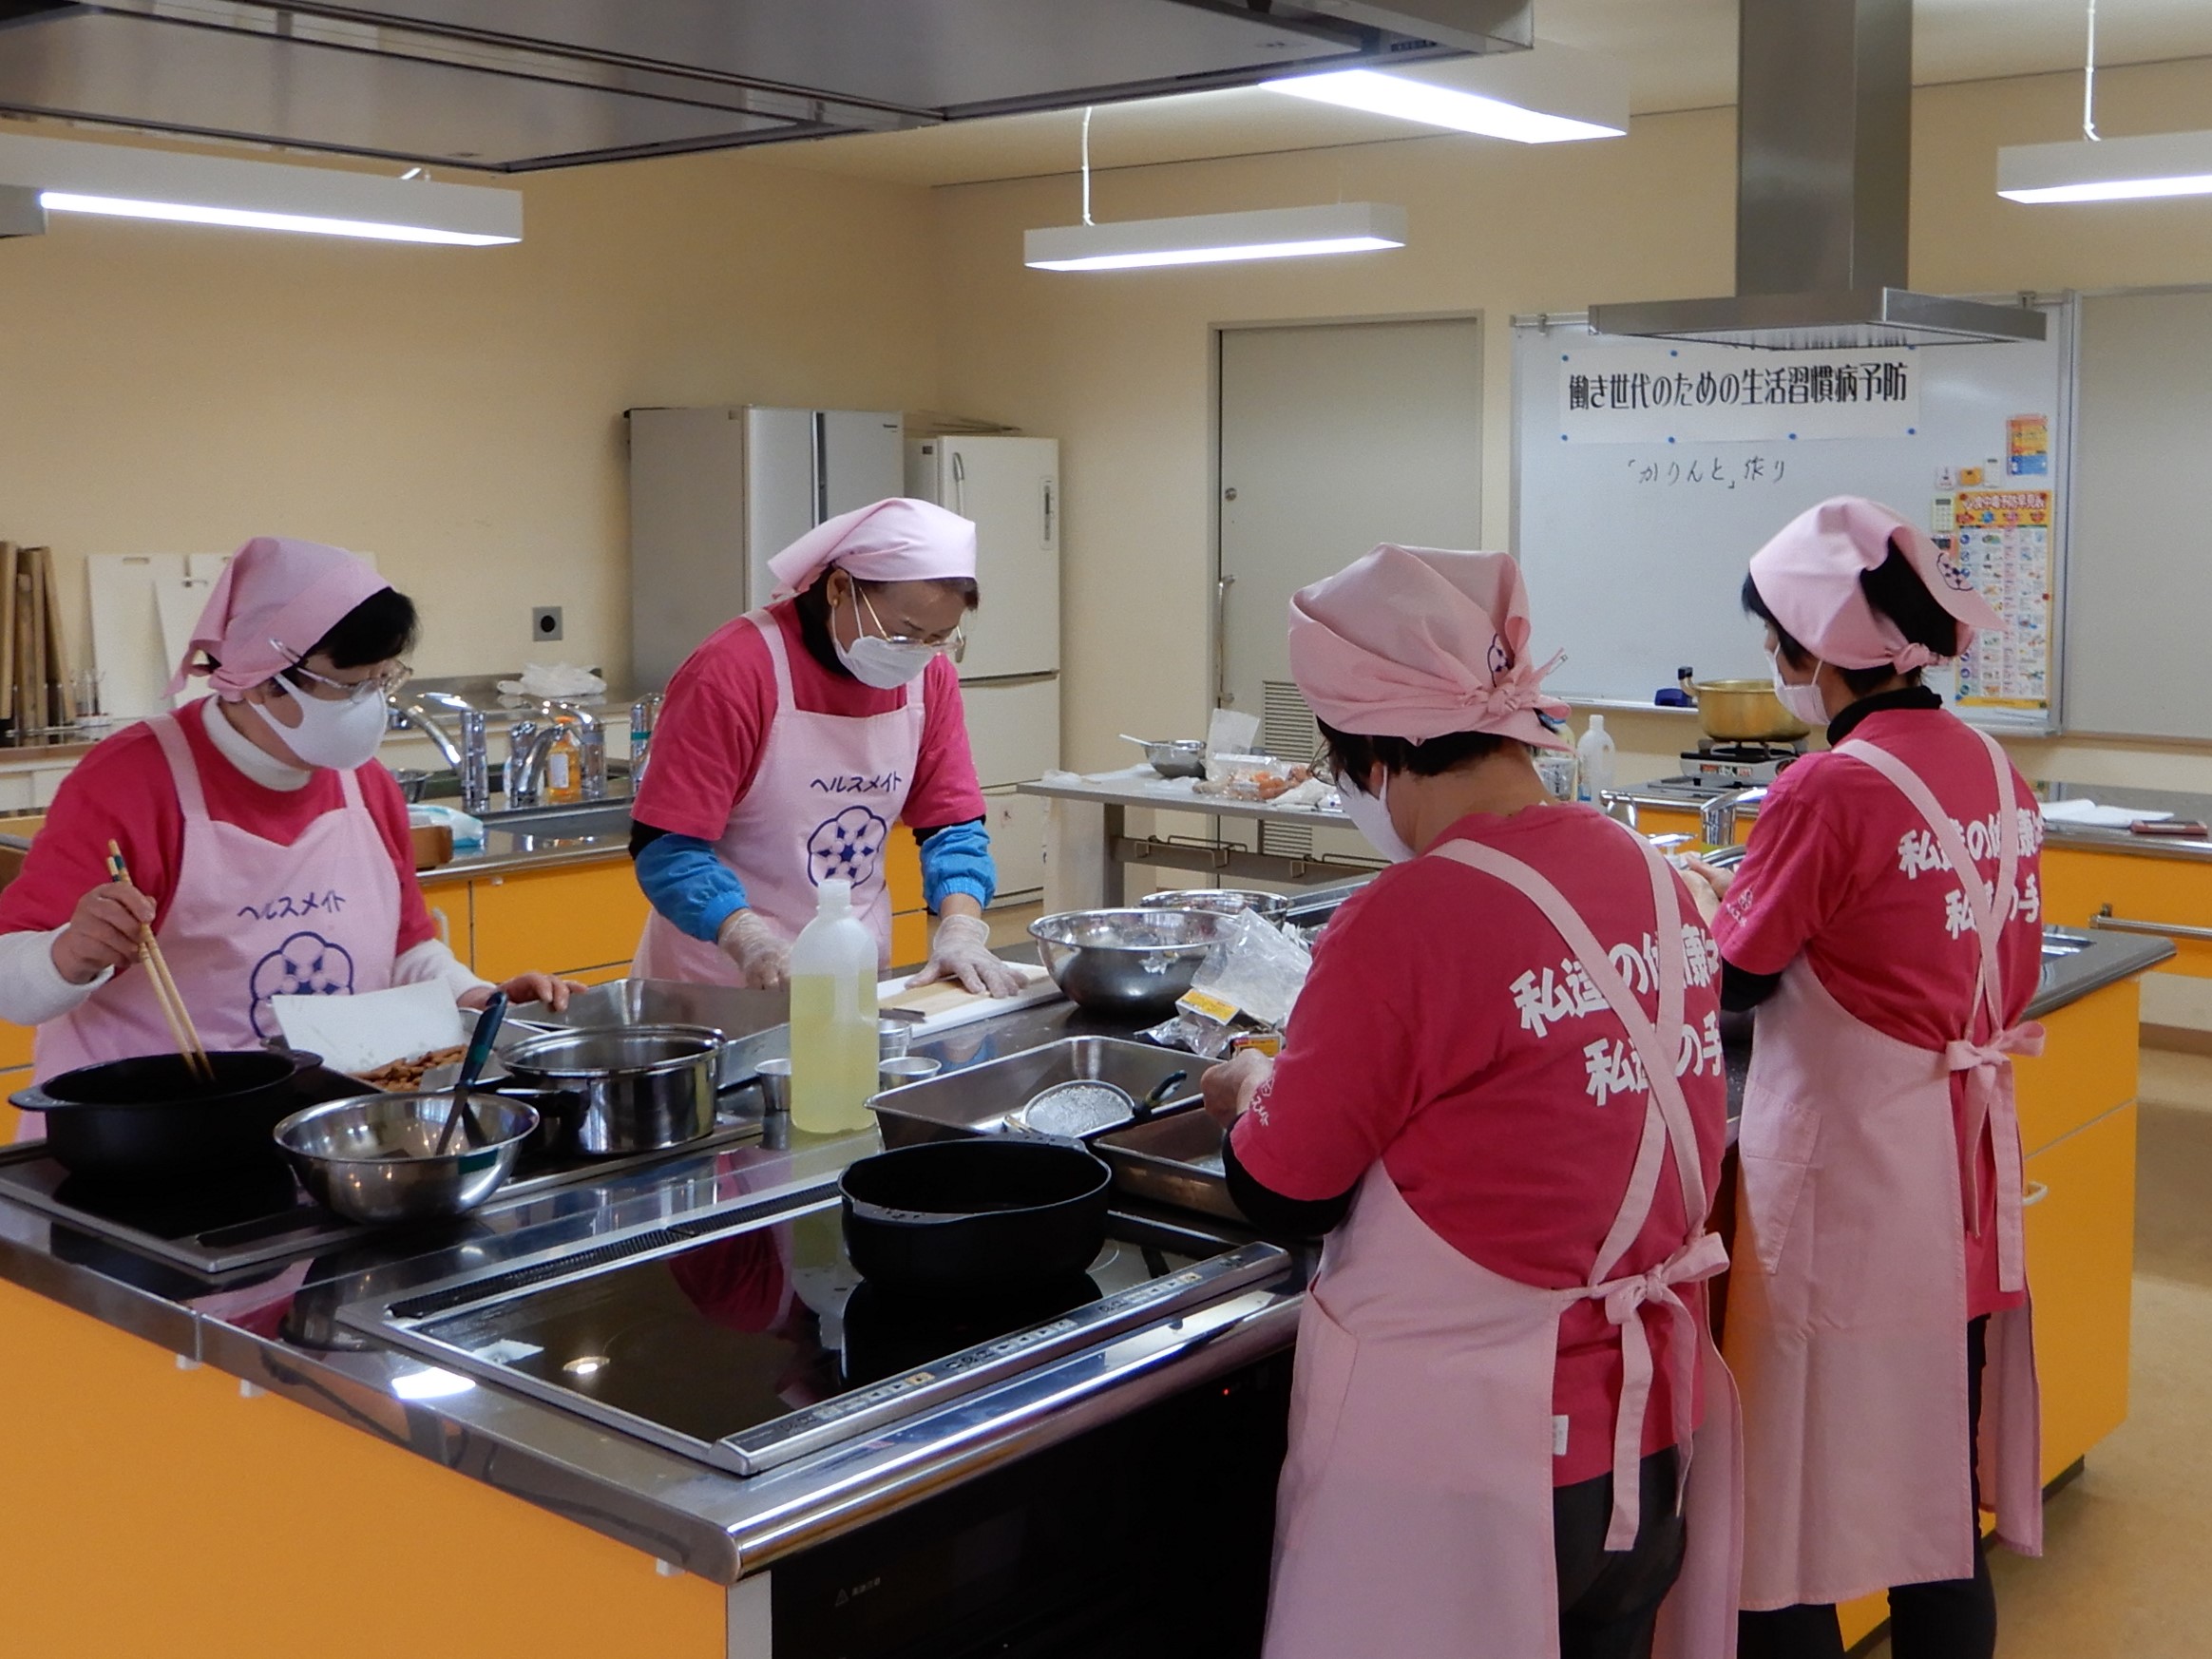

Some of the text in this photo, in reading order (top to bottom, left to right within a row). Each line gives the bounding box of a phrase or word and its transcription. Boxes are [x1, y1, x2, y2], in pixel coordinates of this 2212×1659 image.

[1569, 361, 1908, 410] 働き世代のための生活習慣病予防
[810, 771, 902, 792] ヘルスメイト
[237, 889, 346, 920] ヘルスメイト
